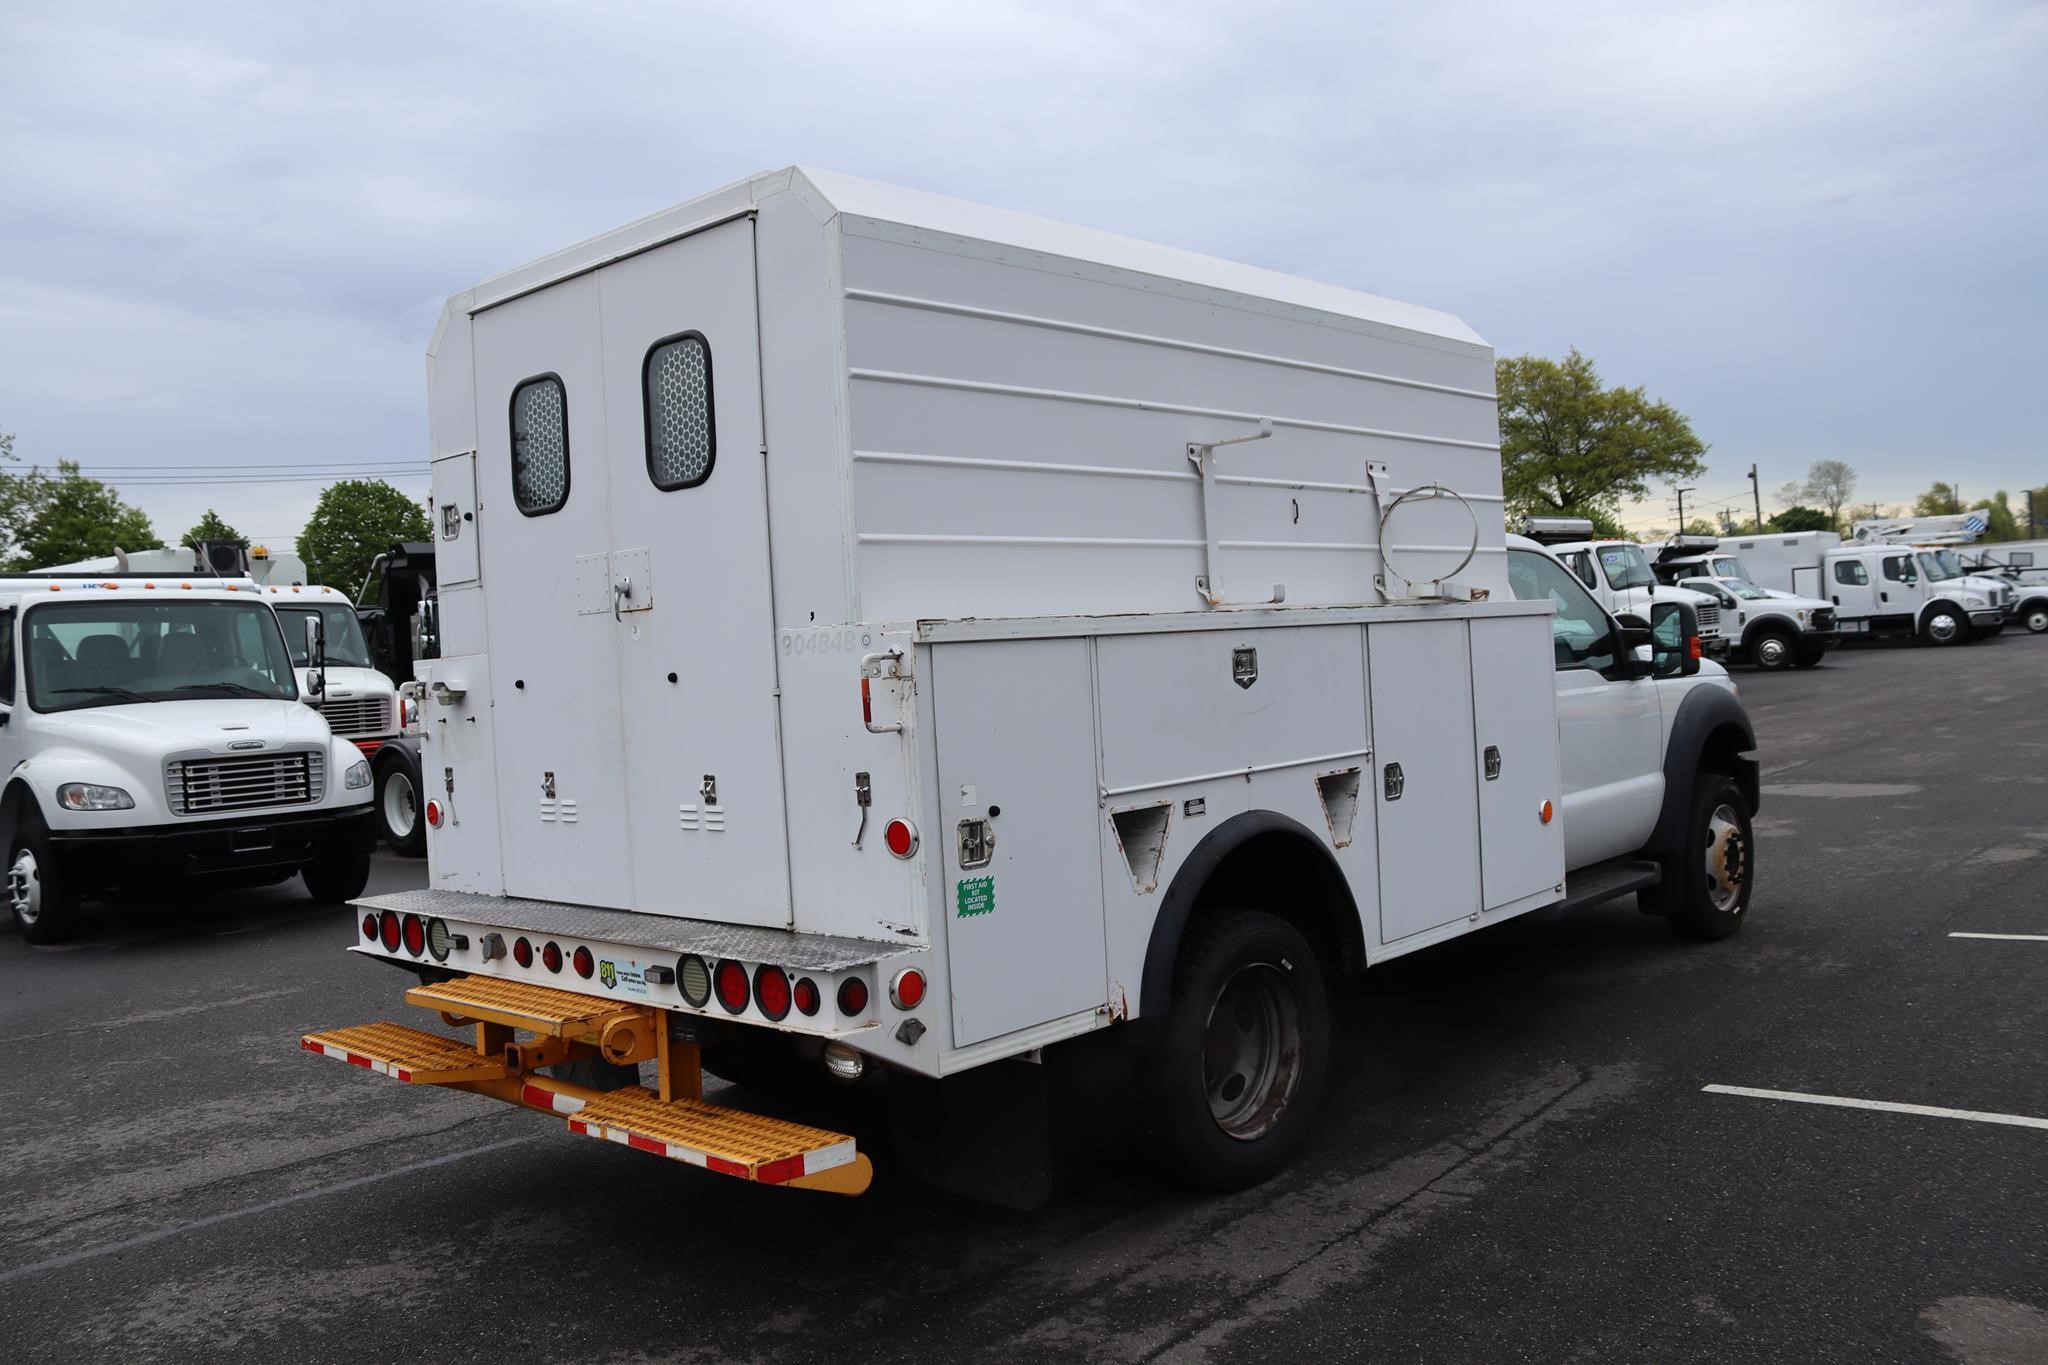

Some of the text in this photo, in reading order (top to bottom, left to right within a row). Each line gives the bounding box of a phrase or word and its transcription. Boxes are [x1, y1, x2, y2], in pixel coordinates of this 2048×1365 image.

[963, 883, 977, 891] FIRST
[964, 895, 988, 904] LOCATED
[967, 902, 985, 910] INSIDE
[600, 961, 615, 980] 811
